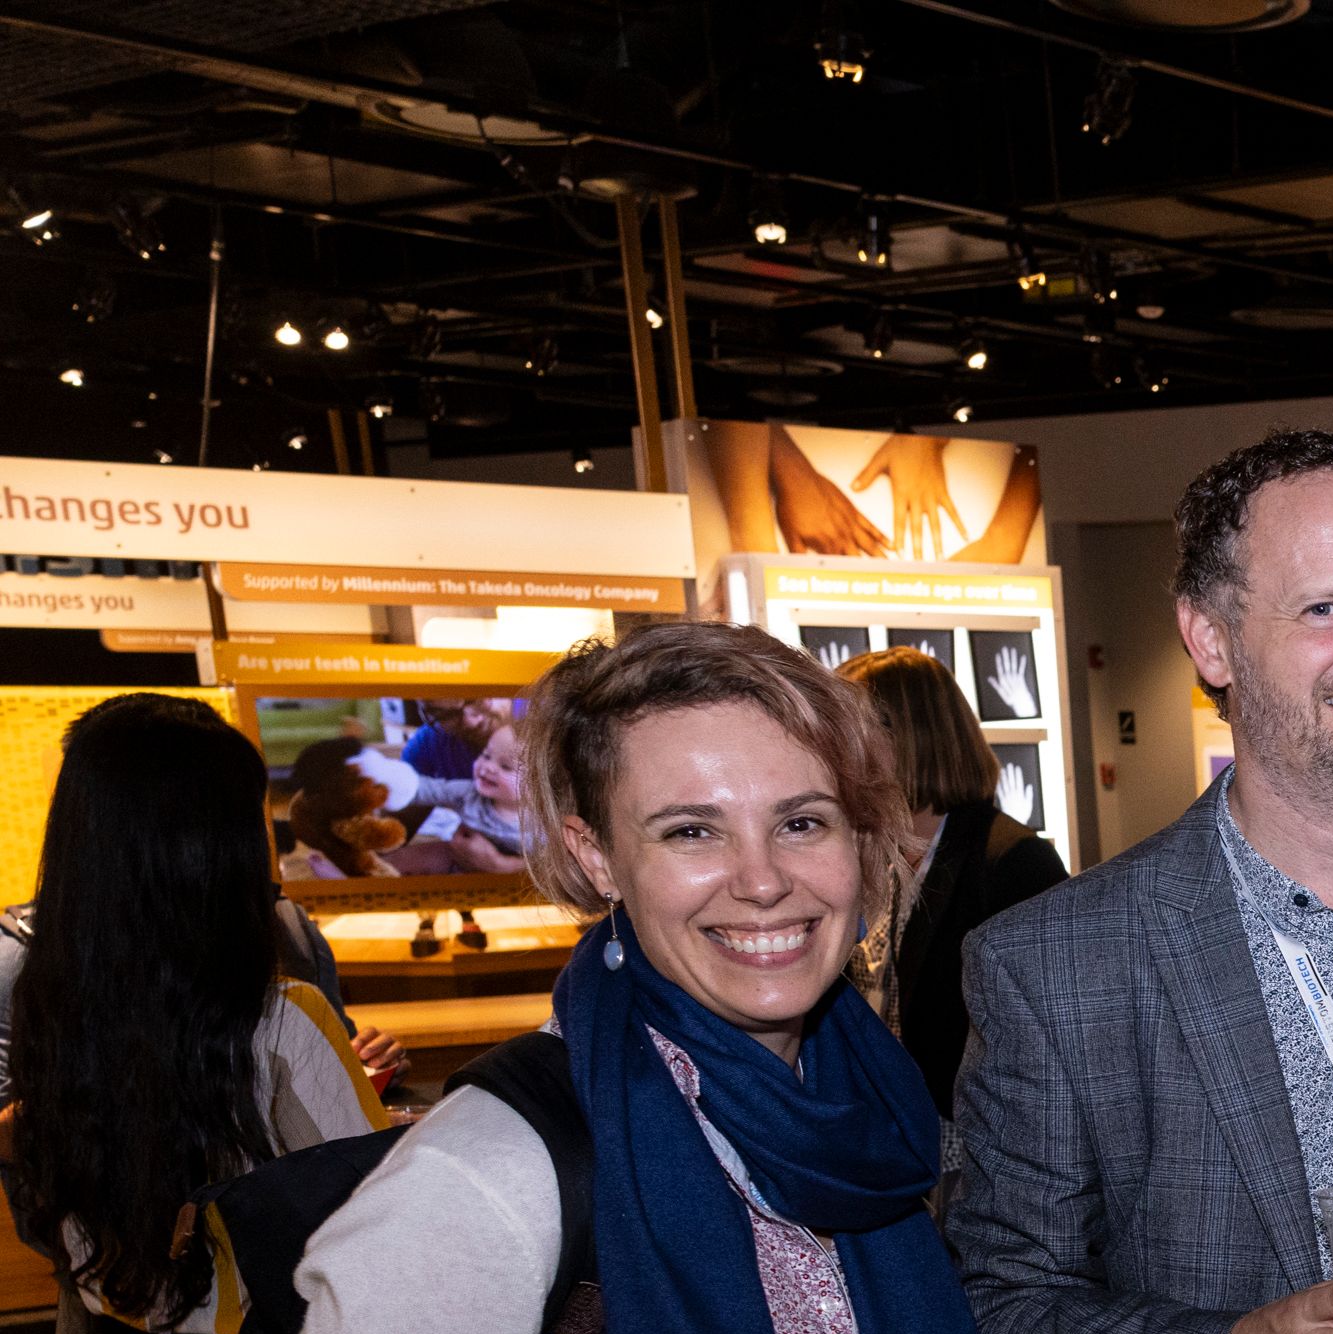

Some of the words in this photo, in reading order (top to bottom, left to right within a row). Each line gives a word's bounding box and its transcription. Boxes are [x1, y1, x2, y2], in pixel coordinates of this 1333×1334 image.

[0, 486, 163, 531] hanges
[173, 503, 250, 534] you
[243, 574, 319, 591] Supported
[322, 576, 340, 592] by
[343, 576, 437, 594] Millennium:
[439, 579, 466, 594] The
[469, 580, 522, 597] Takeda
[524, 582, 592, 600] Oncology
[594, 585, 659, 602] Company
[811, 576, 849, 594] how
[851, 579, 879, 595] our
[881, 578, 930, 597] hands
[0, 591, 84, 612] hanges
[91, 595, 135, 614] you
[238, 653, 268, 669] Are
[272, 656, 311, 673] your
[315, 656, 360, 671] teeth
[364, 657, 380, 671] in
[383, 658, 470, 674] transition?
